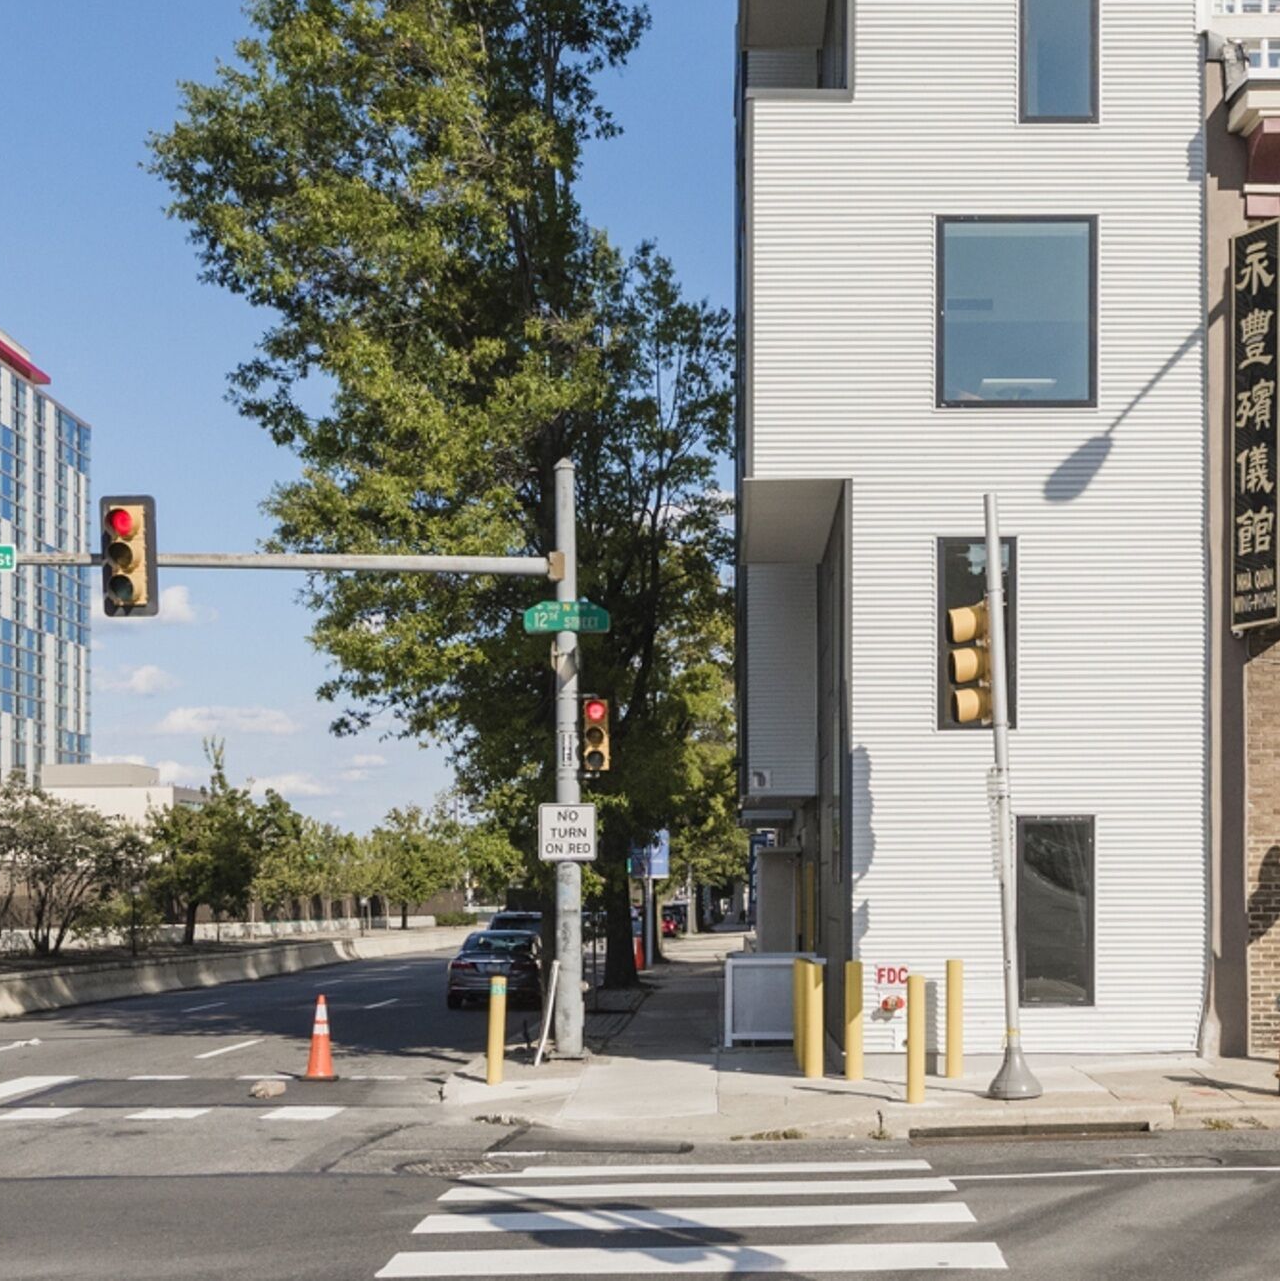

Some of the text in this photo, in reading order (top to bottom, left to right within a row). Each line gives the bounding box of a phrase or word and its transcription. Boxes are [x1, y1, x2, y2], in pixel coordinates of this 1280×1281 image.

[564, 616, 599, 630] STREET
[556, 810, 579, 822] NO
[550, 827, 588, 839] TURN
[545, 842, 591, 854] ON RED
[876, 967, 909, 985] FDC
